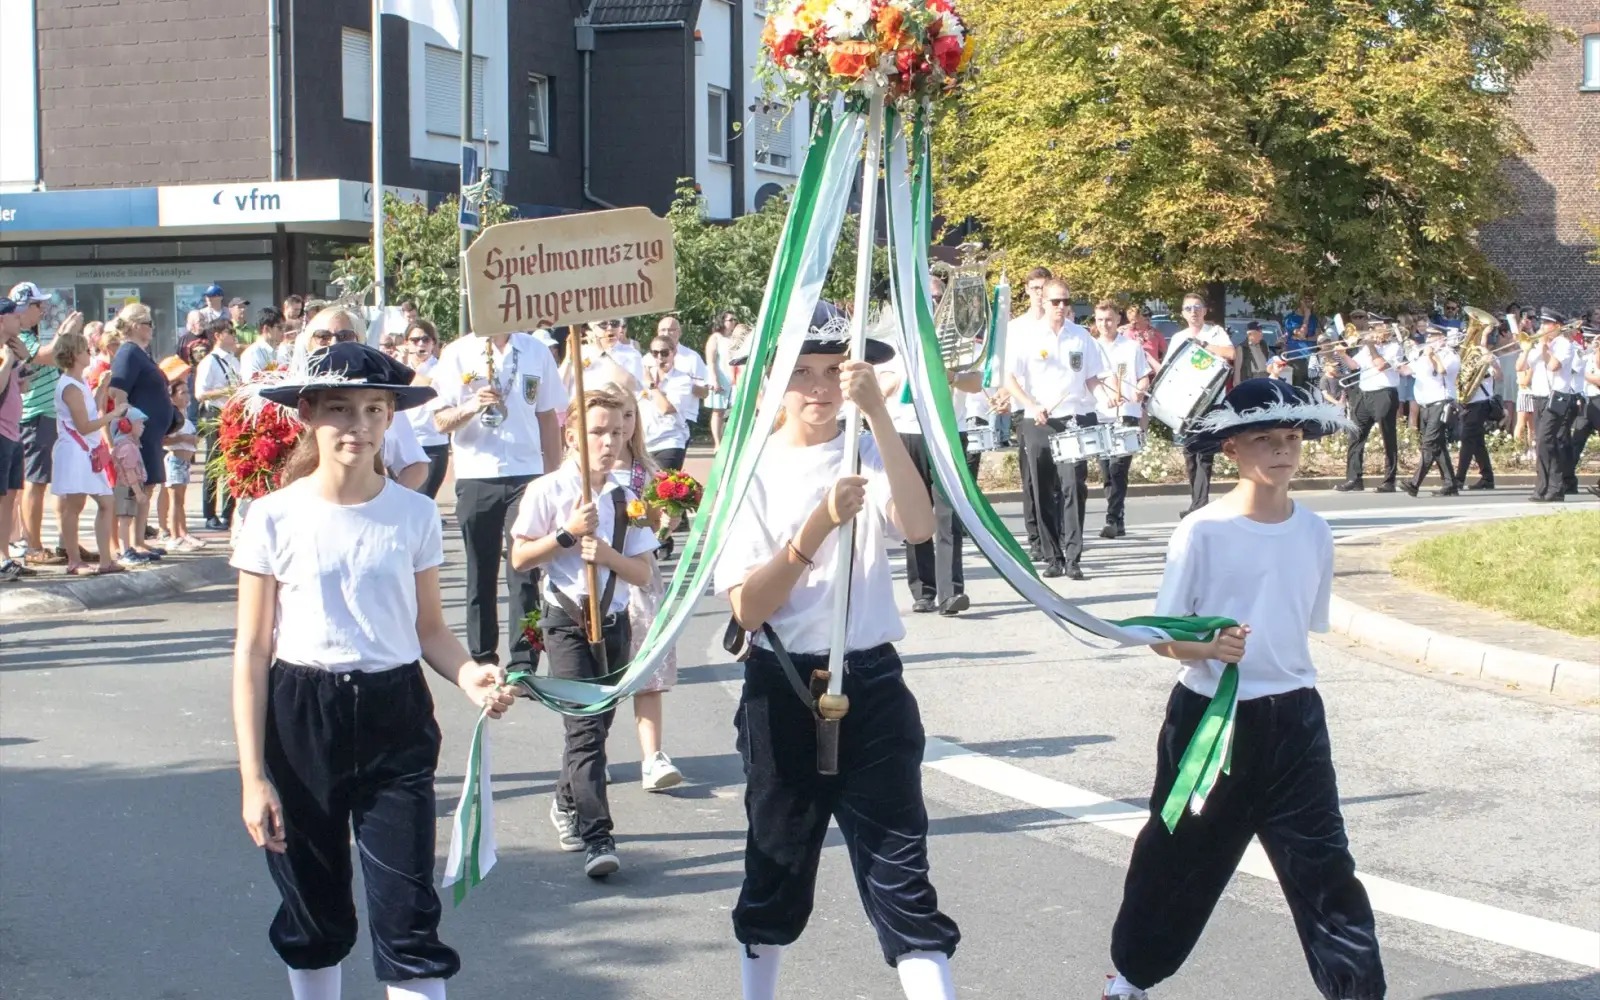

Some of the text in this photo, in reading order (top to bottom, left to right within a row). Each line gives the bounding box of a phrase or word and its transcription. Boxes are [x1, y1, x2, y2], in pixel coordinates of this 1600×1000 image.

[235, 188, 280, 211] vfm
[75, 268, 125, 279] Umfassende
[483, 238, 664, 284] Spielmannszug
[498, 268, 654, 329] Angermund
